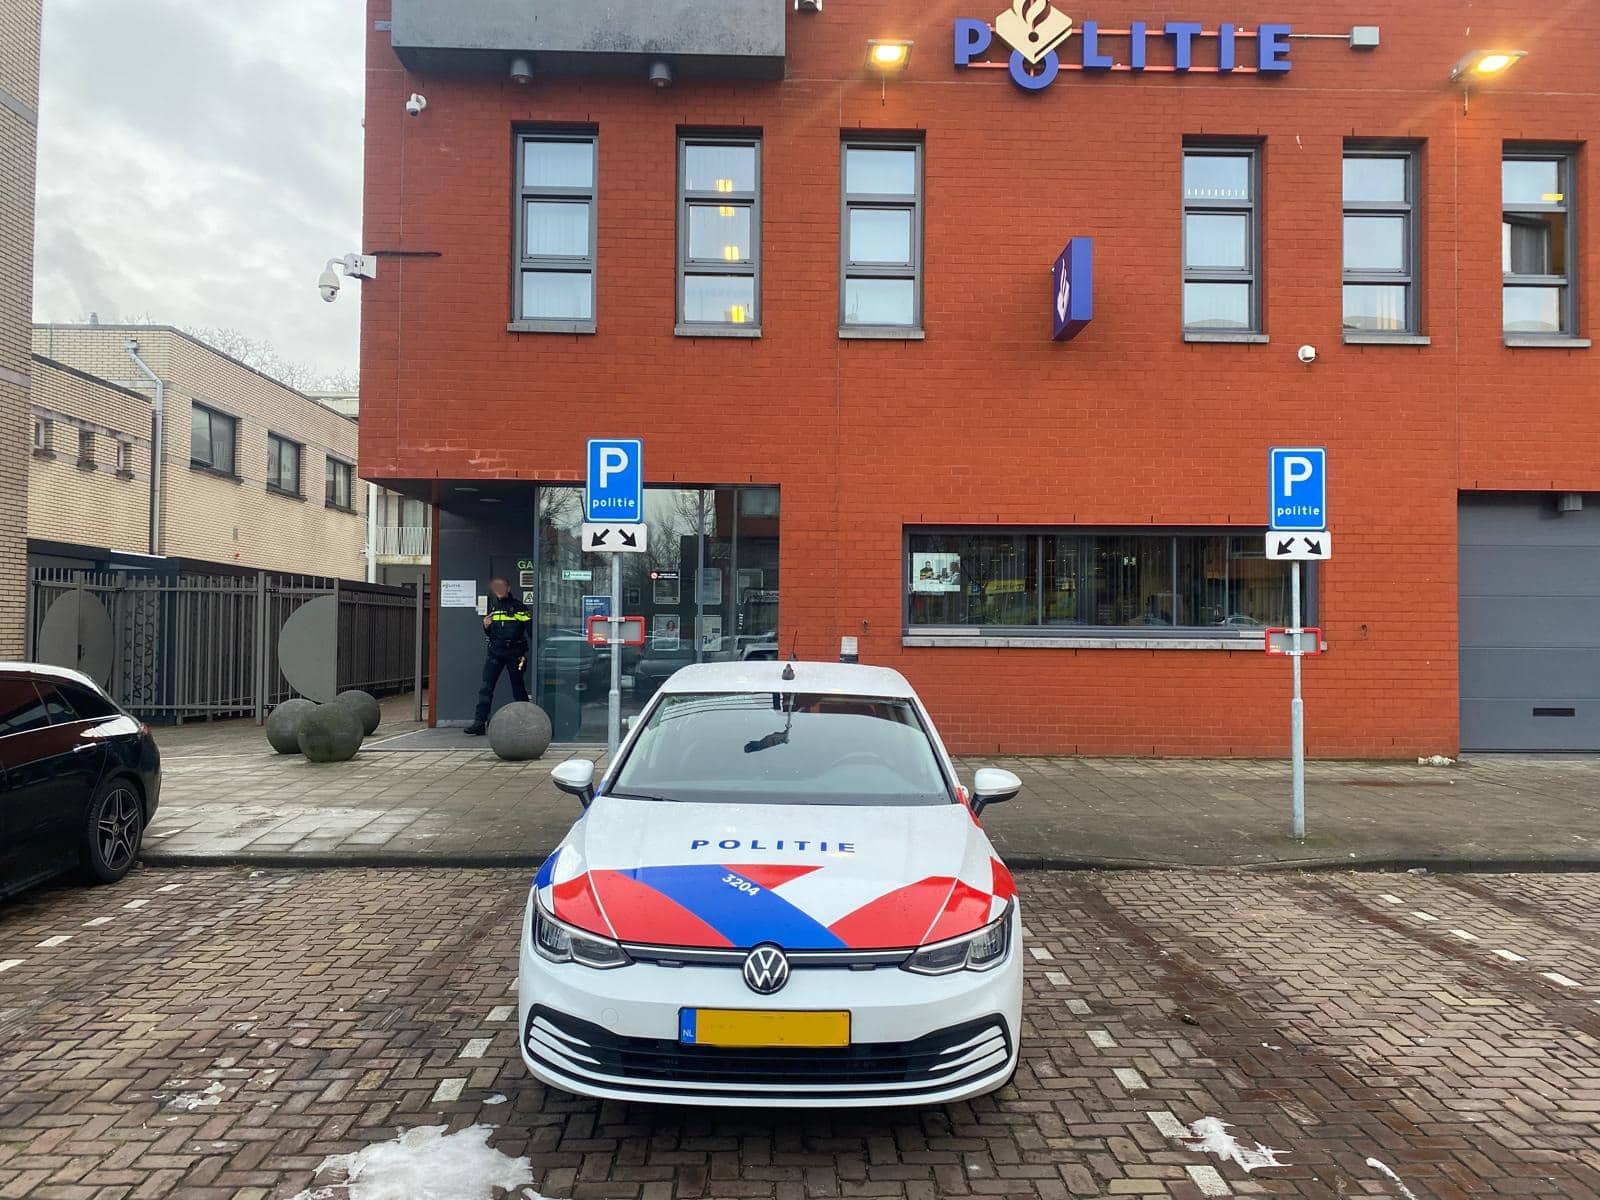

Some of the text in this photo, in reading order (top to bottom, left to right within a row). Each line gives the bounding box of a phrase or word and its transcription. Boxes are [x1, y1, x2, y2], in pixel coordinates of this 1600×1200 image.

[953, 17, 1292, 90] POLITIE
[600, 447, 629, 488] P
[1283, 456, 1313, 497] P
[592, 497, 635, 509] politie
[1277, 506, 1320, 517] politie
[690, 839, 856, 854] POLITIE
[721, 873, 761, 897] 3204
[682, 1029, 695, 1038] NL
